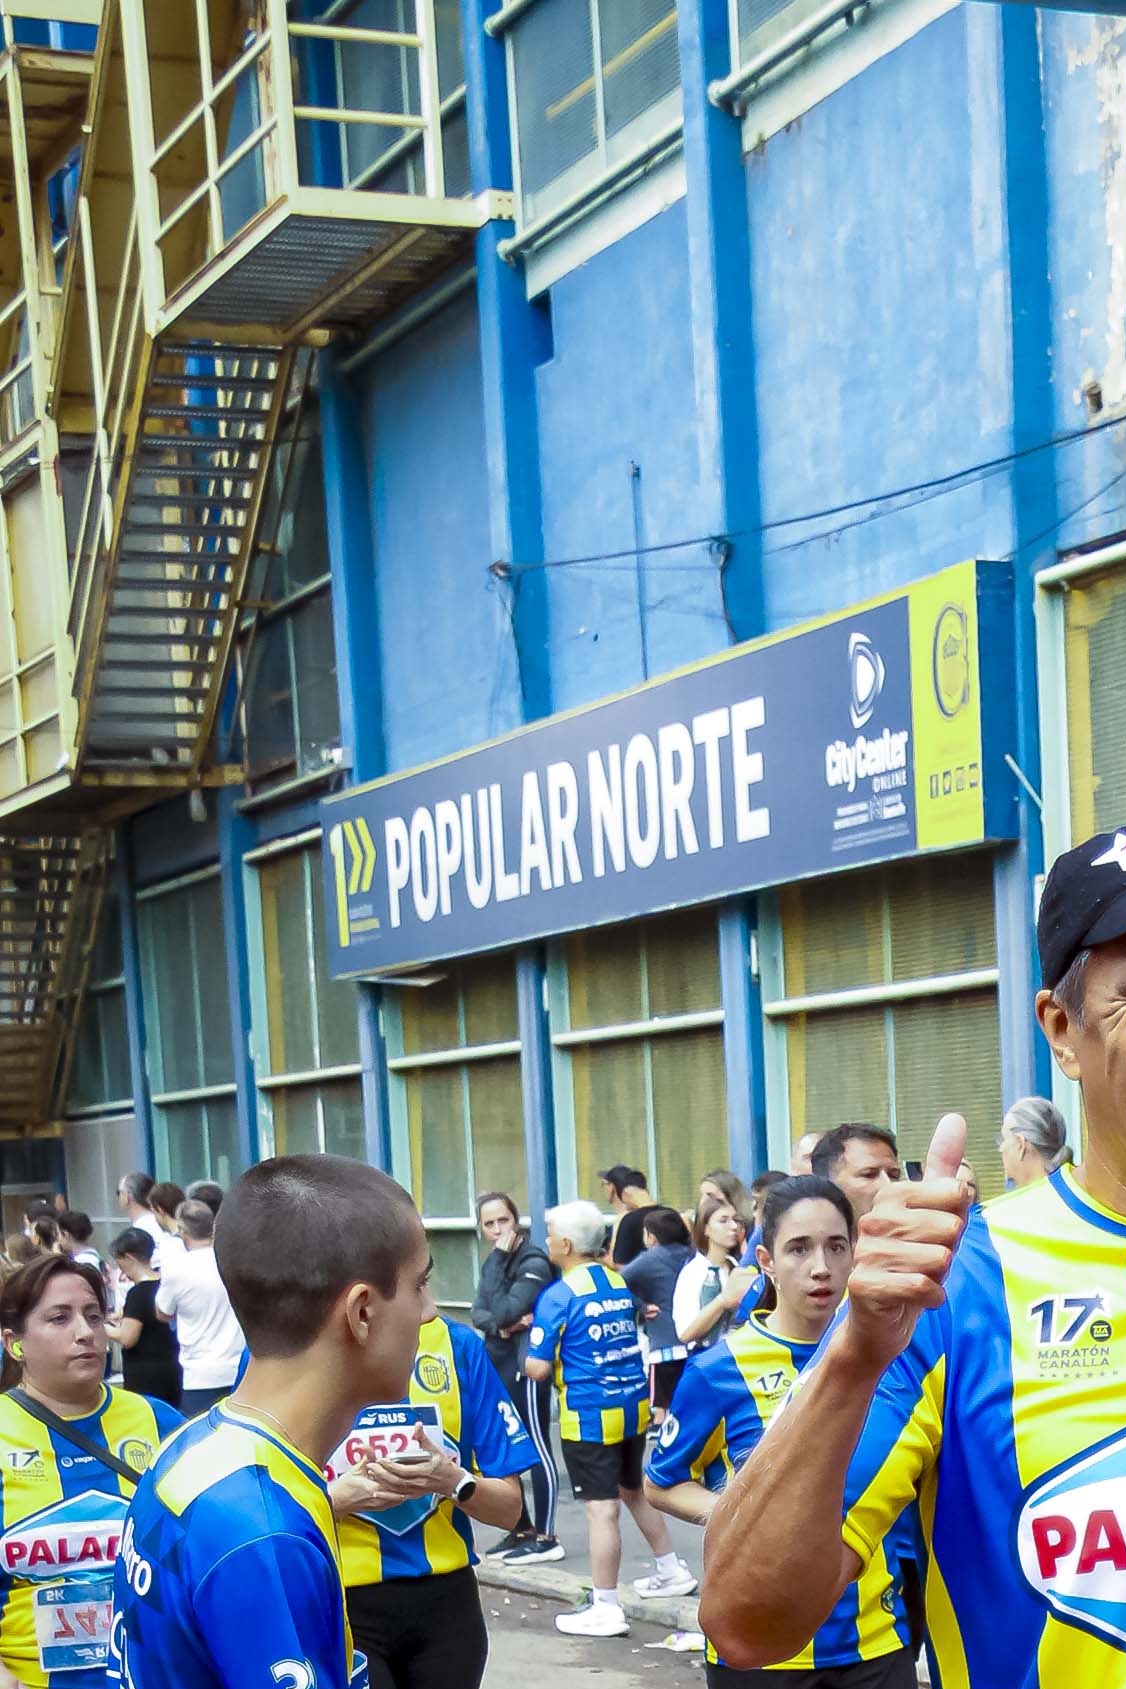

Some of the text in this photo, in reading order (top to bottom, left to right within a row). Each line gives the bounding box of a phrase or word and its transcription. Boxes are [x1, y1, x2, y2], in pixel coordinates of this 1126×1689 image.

[384, 697, 769, 929] POPULAR NORTE
[1030, 1297, 1102, 1343] 17
[1038, 1345, 1109, 1359] MARATÓN
[1040, 1357, 1109, 1369] CANALLA
[378, 1412, 407, 1424] RUS
[345, 1433, 420, 1466] 652
